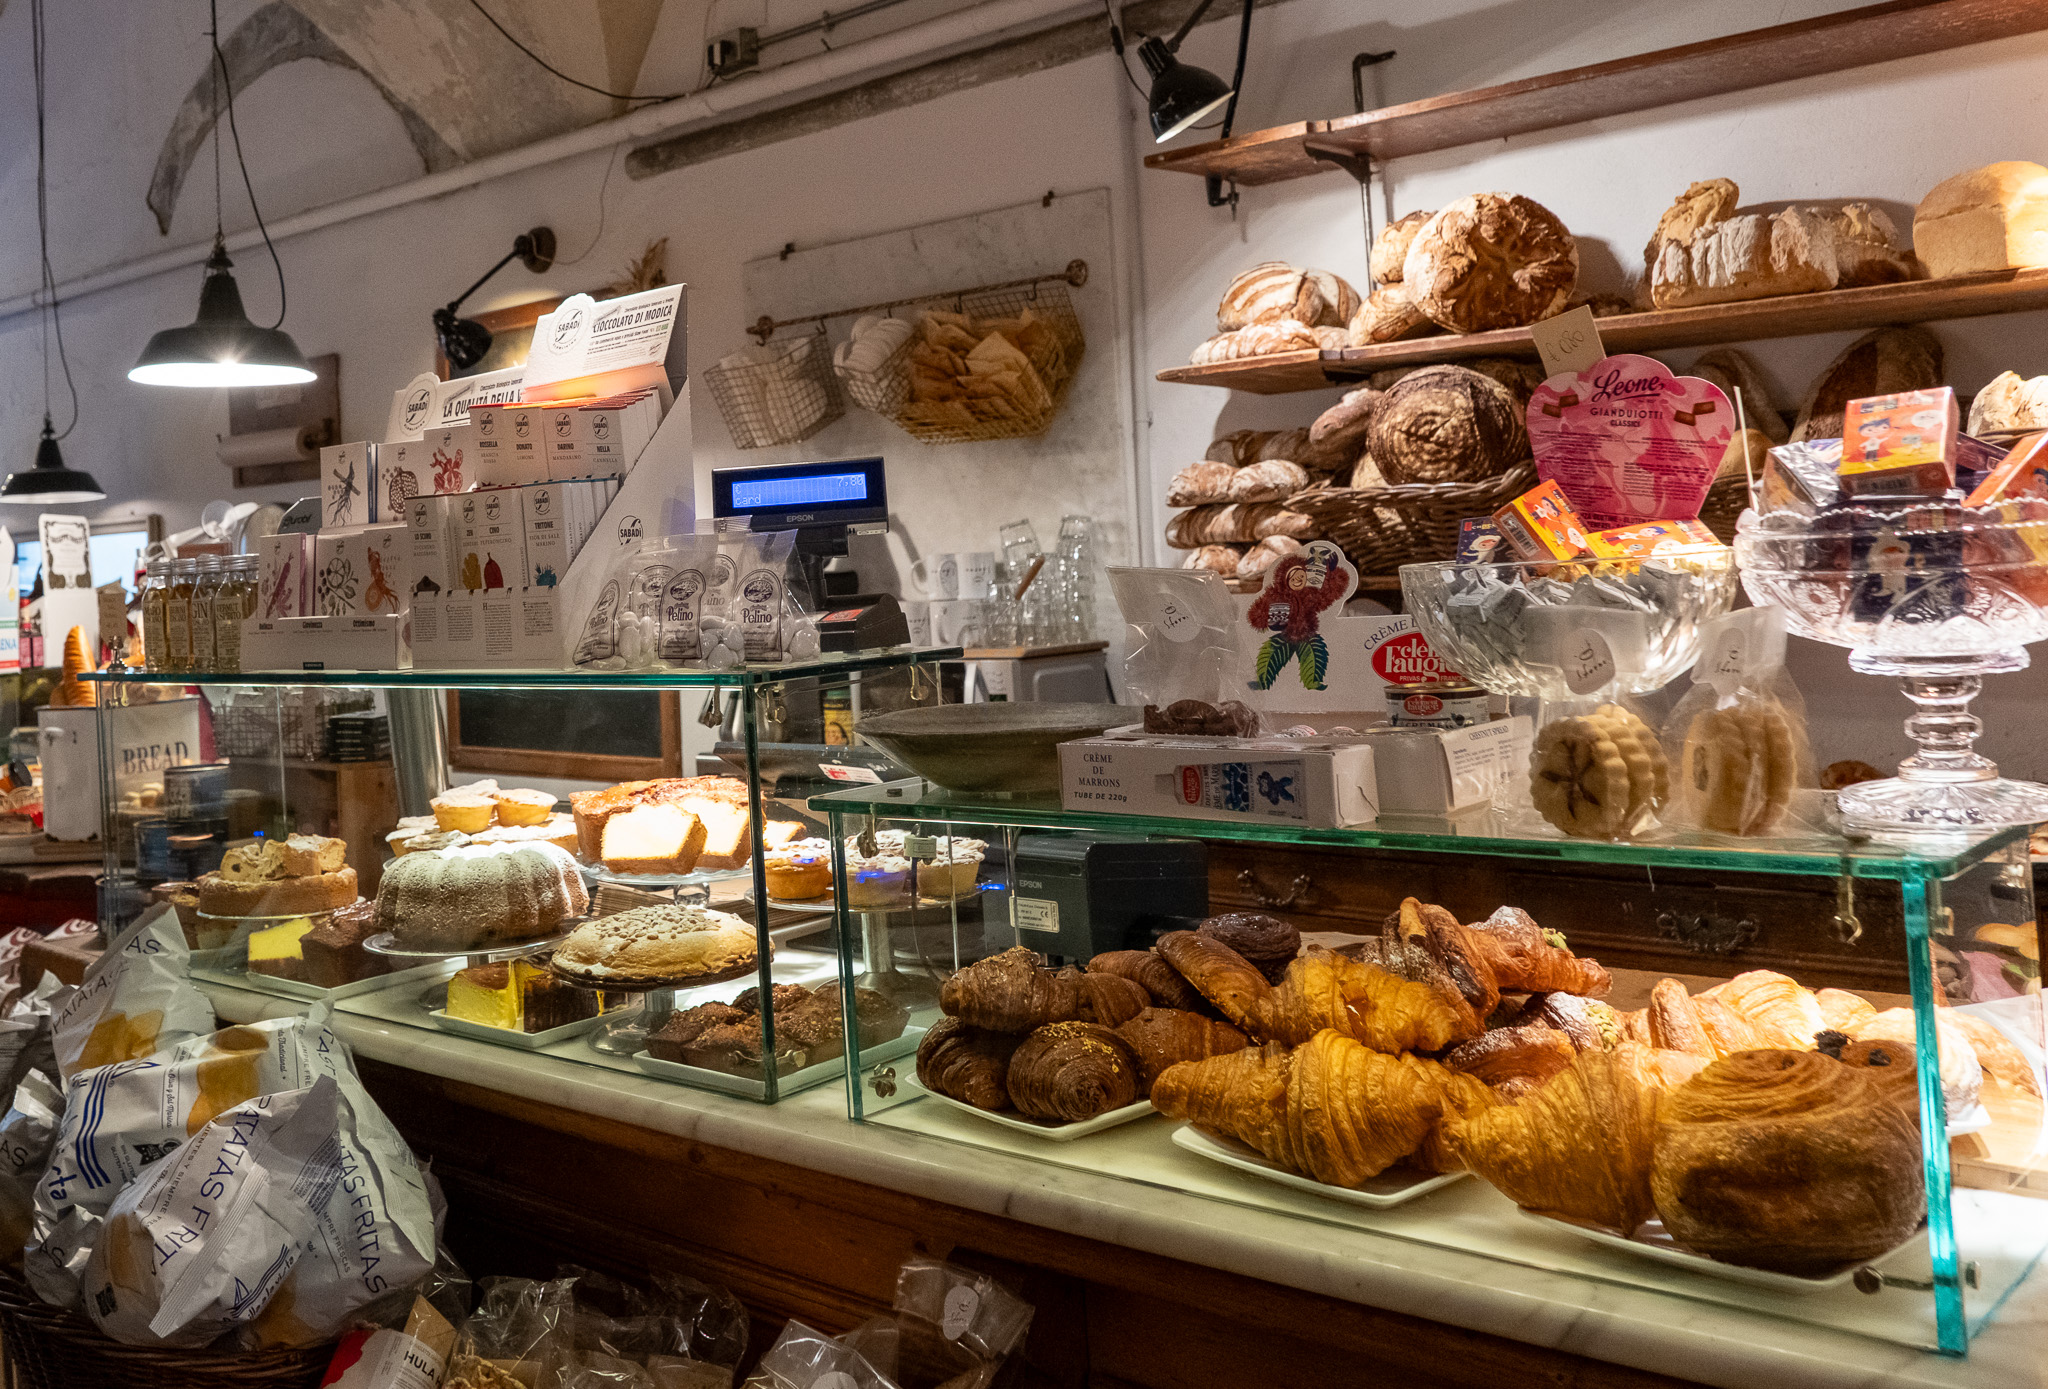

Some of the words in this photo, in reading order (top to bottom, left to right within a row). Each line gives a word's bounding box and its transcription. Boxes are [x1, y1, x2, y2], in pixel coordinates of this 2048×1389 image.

[592, 313, 634, 334] CIOCCOLATO
[634, 311, 644, 324] DI
[644, 304, 673, 321] MODICA
[1591, 368, 1664, 403] Leone
[442, 403, 454, 418] LA
[516, 443, 533, 451] DONATO
[596, 445, 611, 453] NELLA
[837, 474, 864, 488] 7,80
[734, 493, 762, 506] card
[534, 521, 554, 529] TRITONE
[786, 513, 814, 524] EPSON
[192, 602, 208, 619] GIN
[665, 605, 694, 622] Pelino
[741, 608, 773, 623] Pelino
[1363, 618, 1408, 650] CRÈME
[123, 741, 189, 775] BREAD
[1083, 752, 1113, 763] CRÈME
[1092, 766, 1104, 775] DE
[1078, 777, 1121, 788] MARRONS
[1074, 791, 1093, 799] TUBE
[1108, 793, 1128, 803] 220g
[1203, 781, 1211, 806] DEPUIS
[1019, 880, 1043, 889] EPSON
[110, 1146, 123, 1168] GLUTEN
[160, 1170, 185, 1214] SIEMPRE
[350, 1194, 389, 1295] FRITAS
[331, 1235, 352, 1274] FRESCAS
[403, 1350, 436, 1382] HULA
